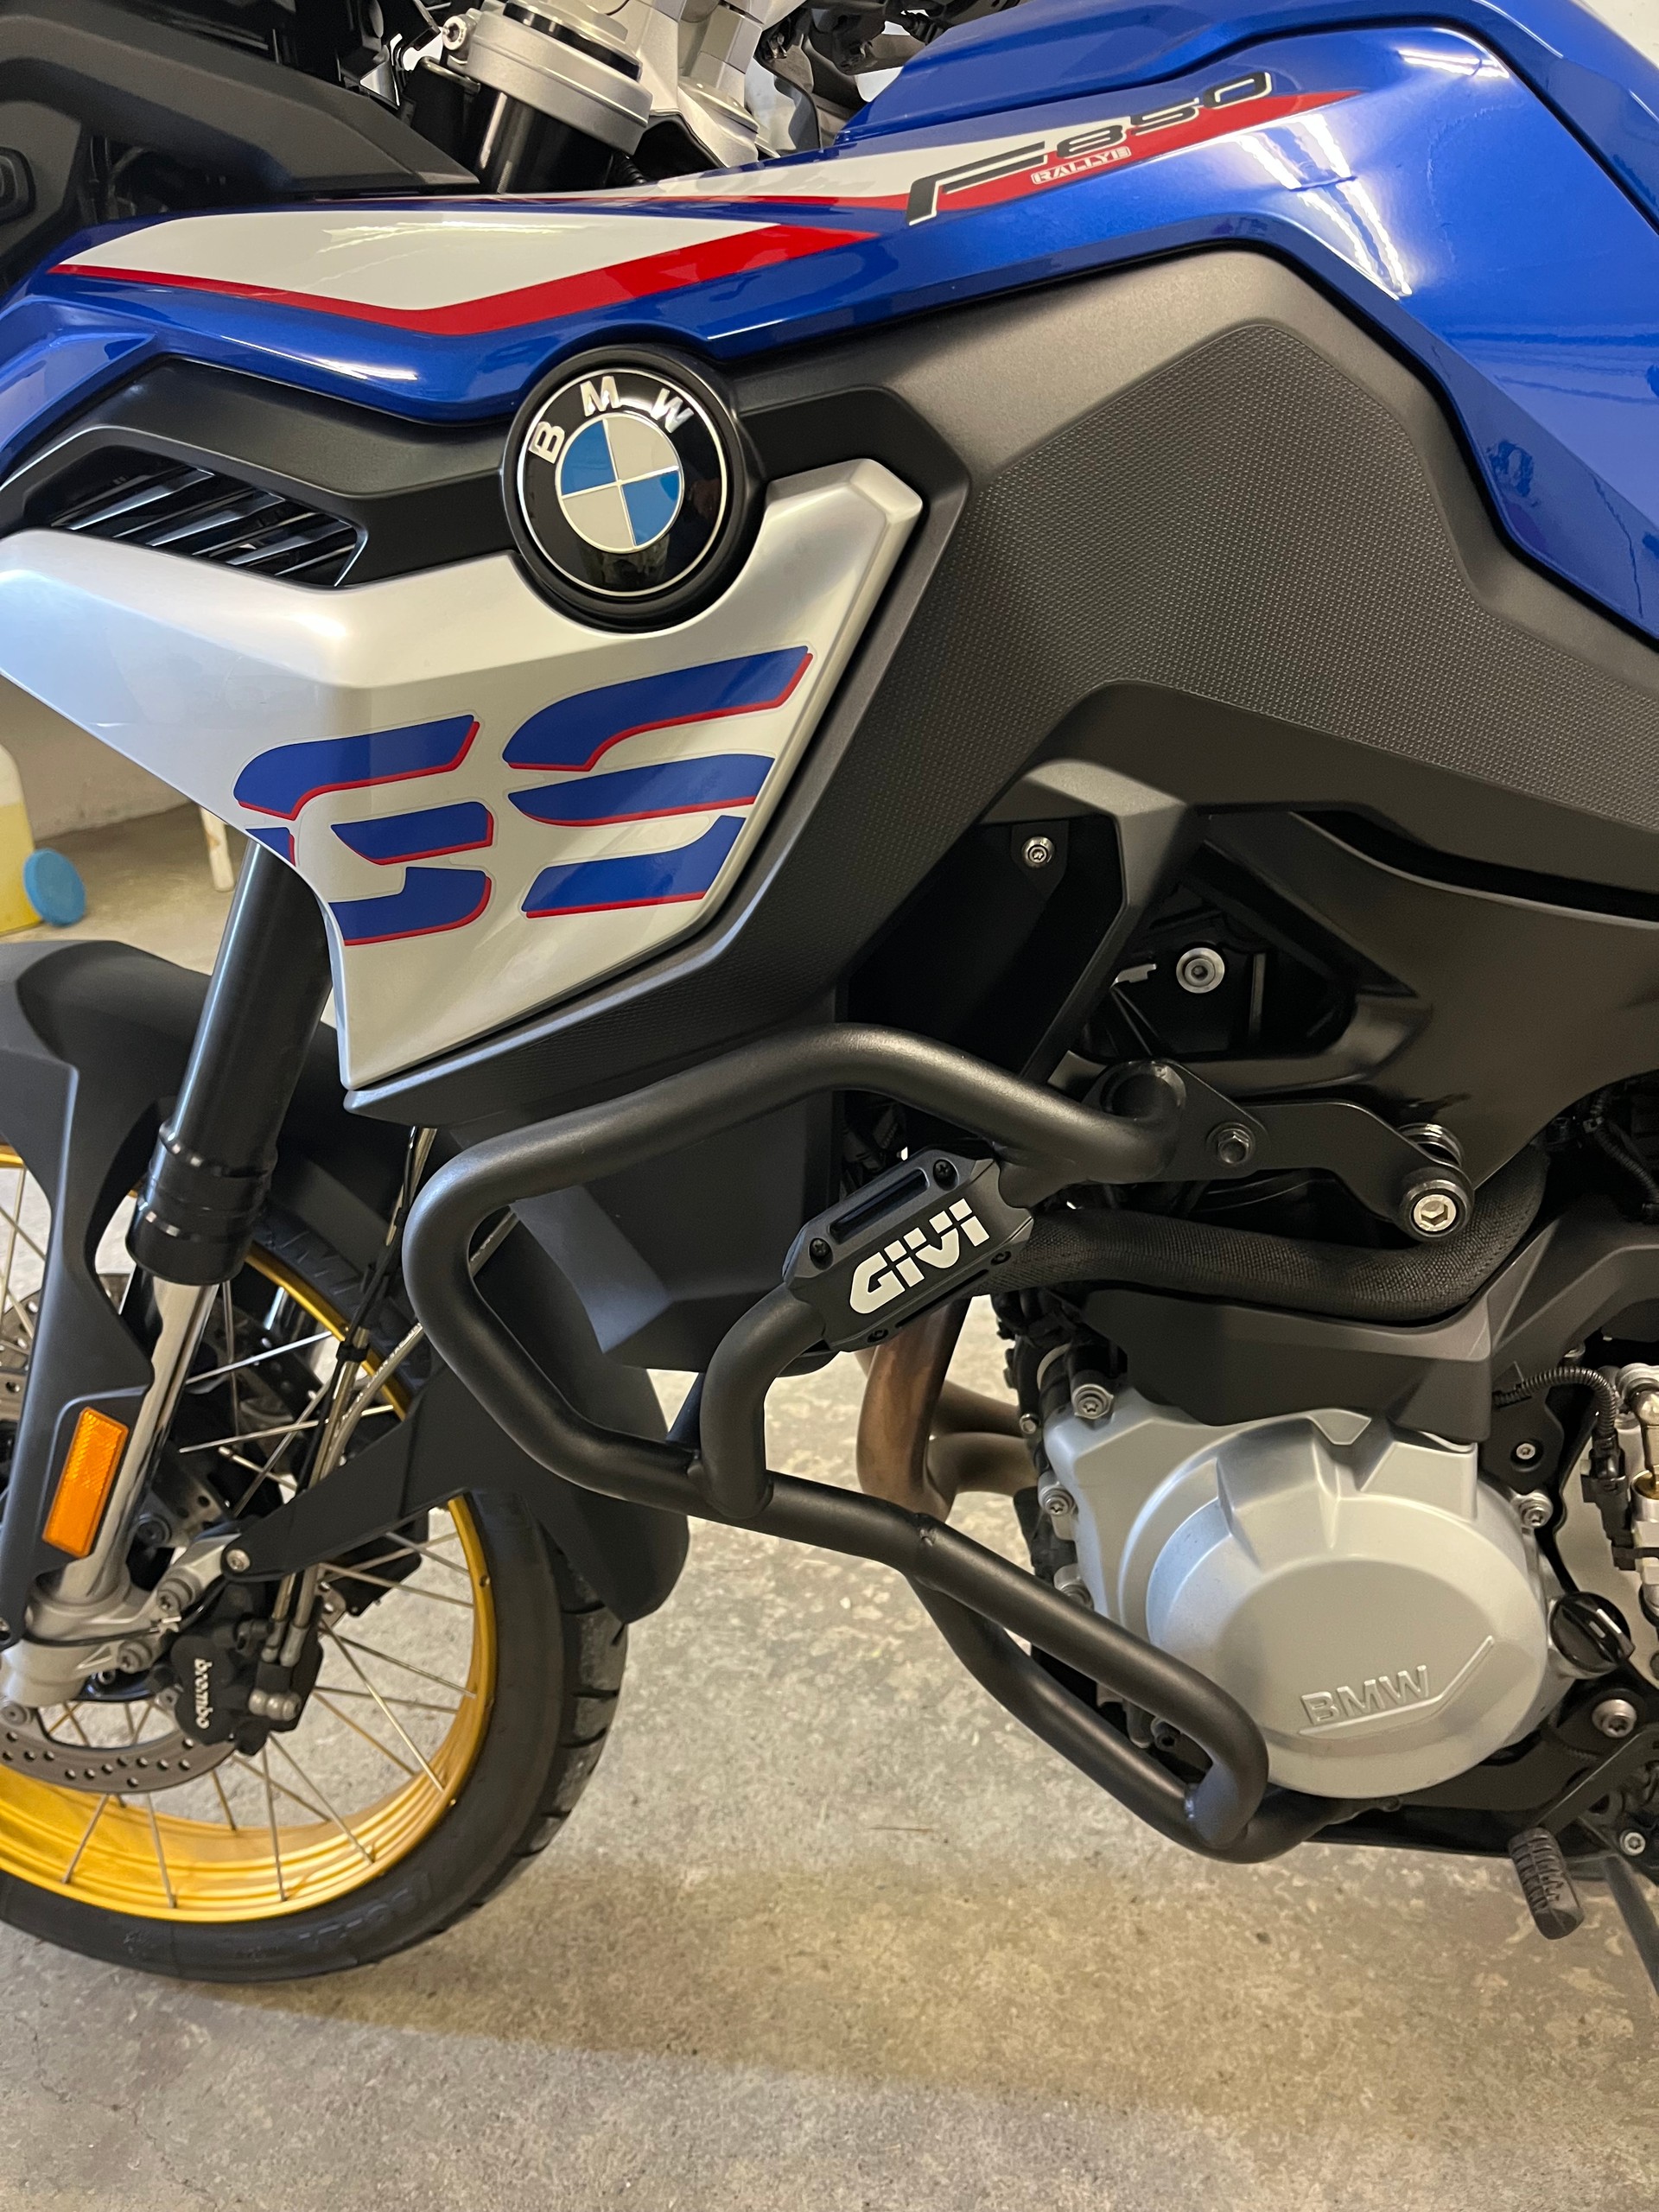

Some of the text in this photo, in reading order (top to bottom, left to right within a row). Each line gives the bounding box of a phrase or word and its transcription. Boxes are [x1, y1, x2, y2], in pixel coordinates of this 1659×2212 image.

[1031, 146, 1131, 184] RALLYE
[529, 375, 695, 464] BMW
[194, 1657, 213, 1730] brembo
[1300, 1664, 1429, 1726] BMW
